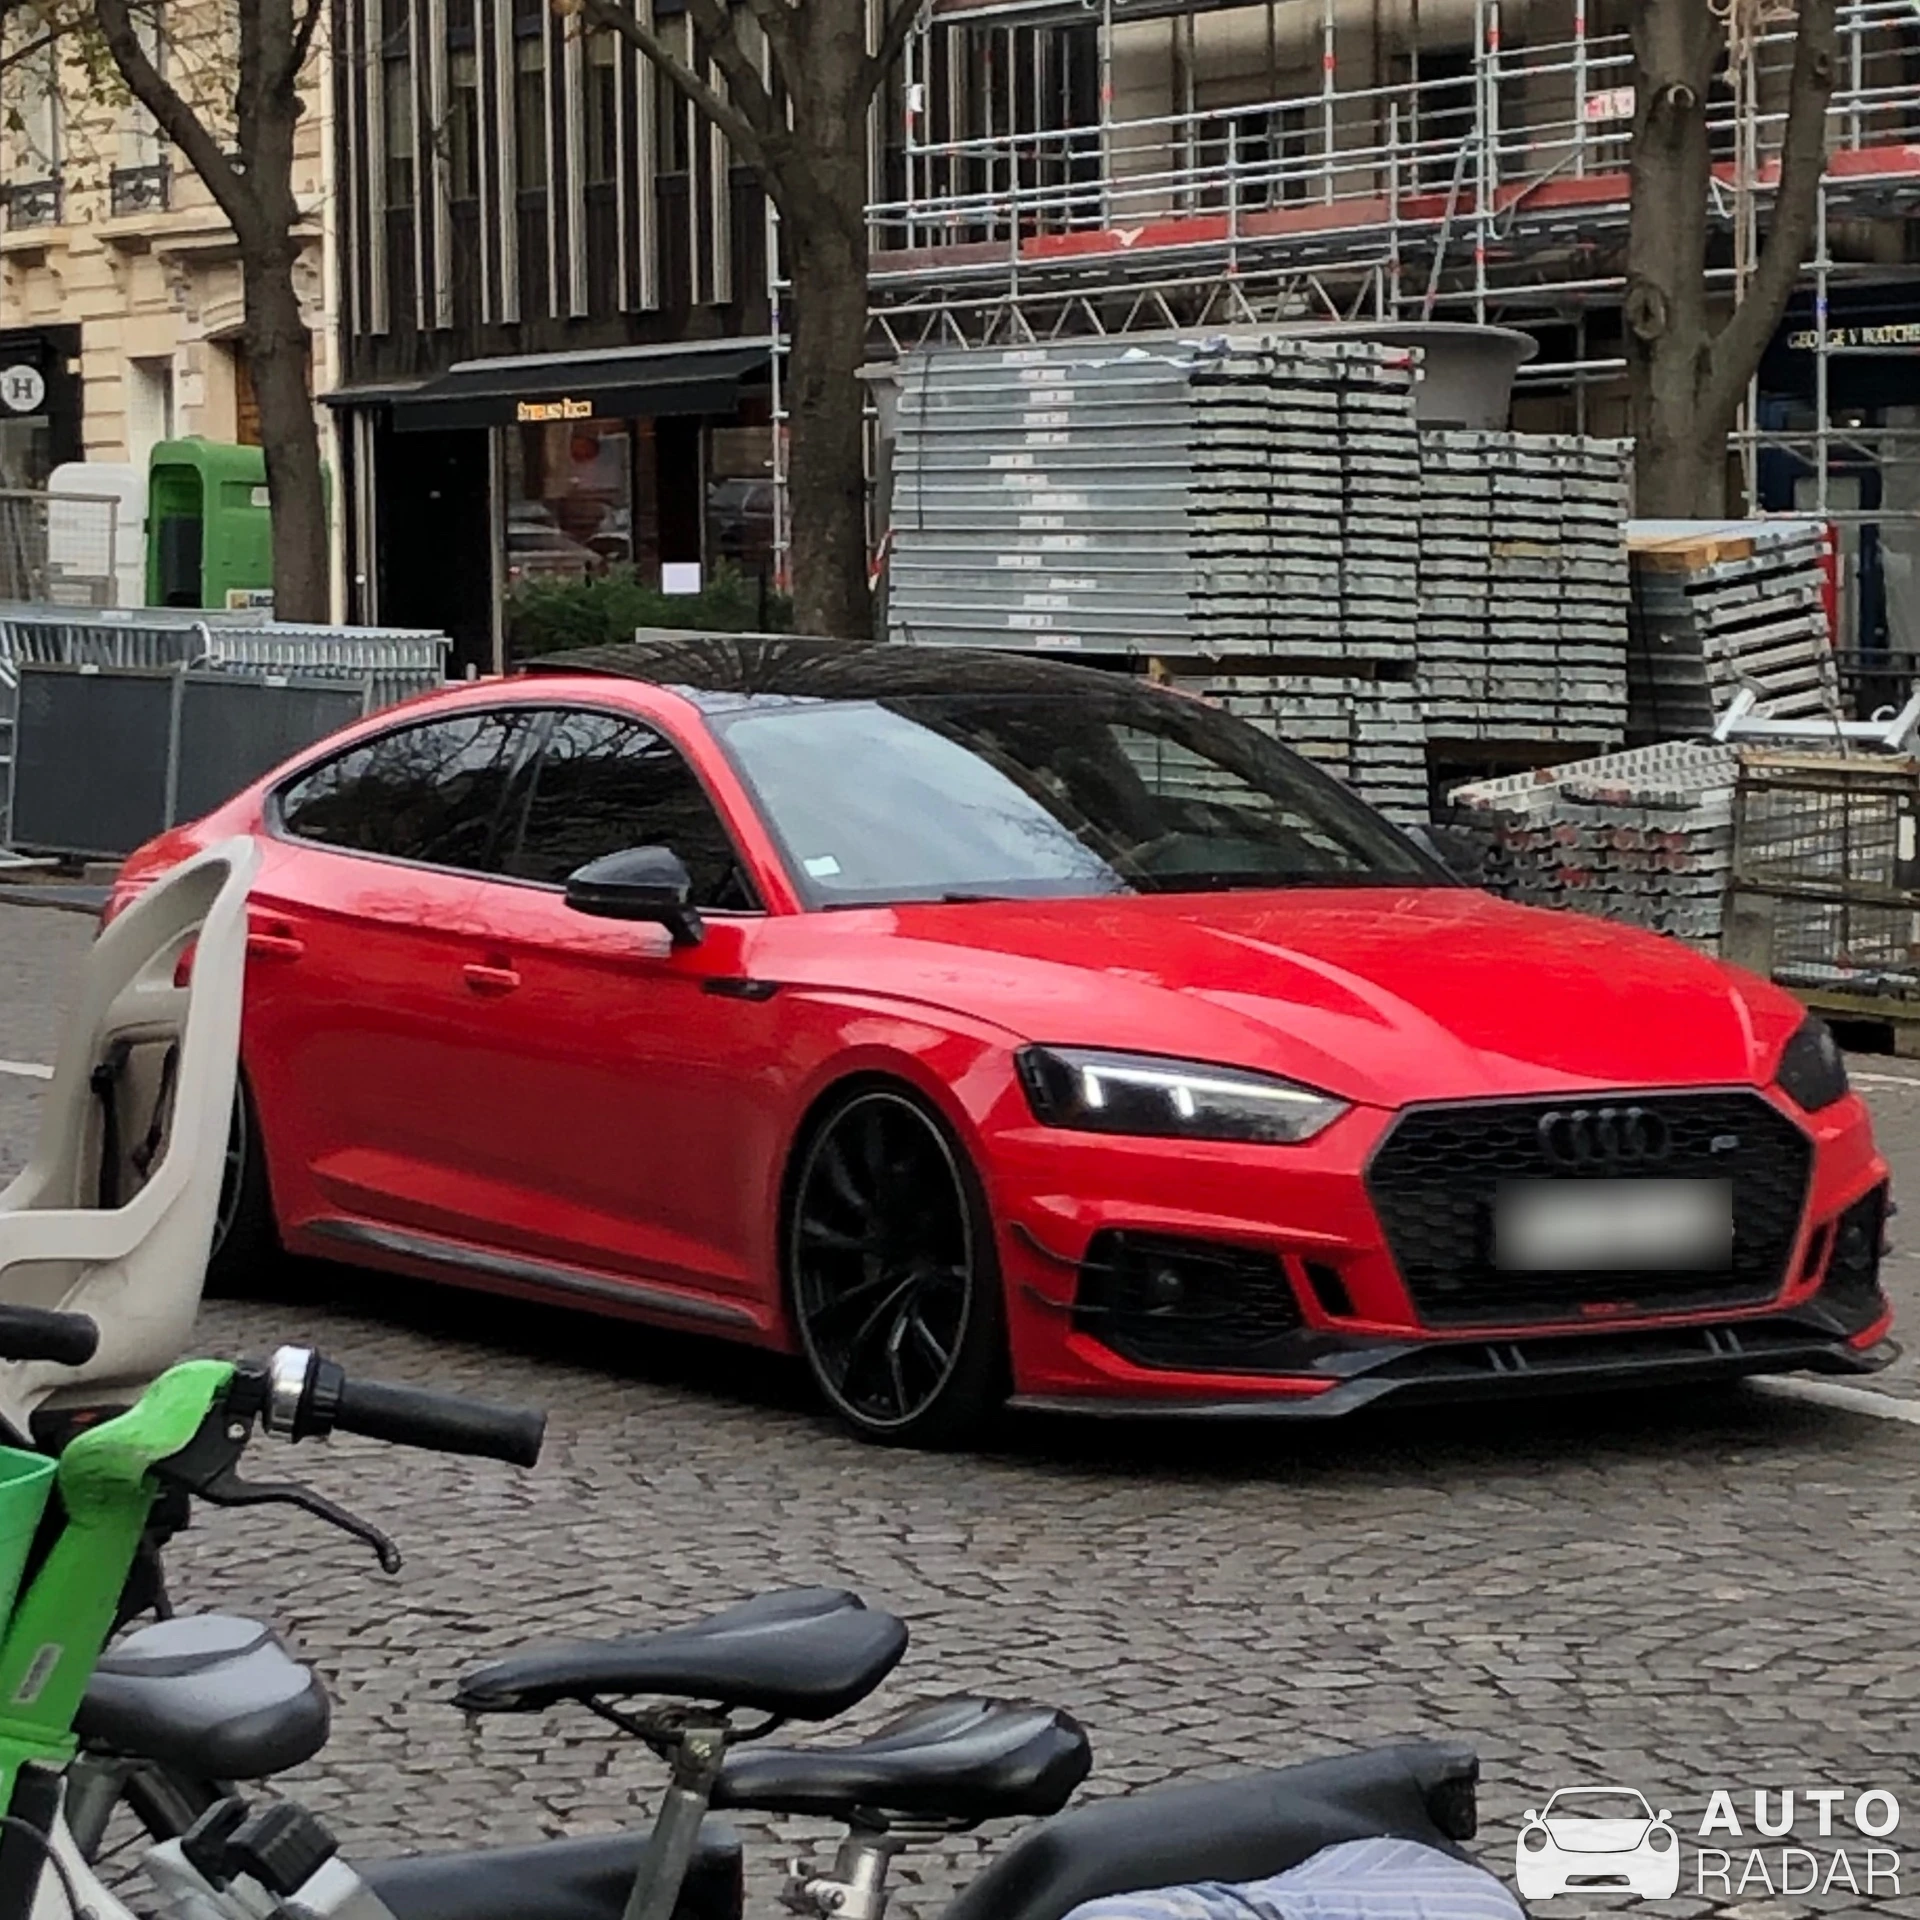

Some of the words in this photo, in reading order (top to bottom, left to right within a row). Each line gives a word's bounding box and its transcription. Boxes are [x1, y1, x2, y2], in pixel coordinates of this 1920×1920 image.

[1787, 328, 1845, 348] GEOGE
[1848, 327, 1860, 345] V
[12, 377, 34, 400] H
